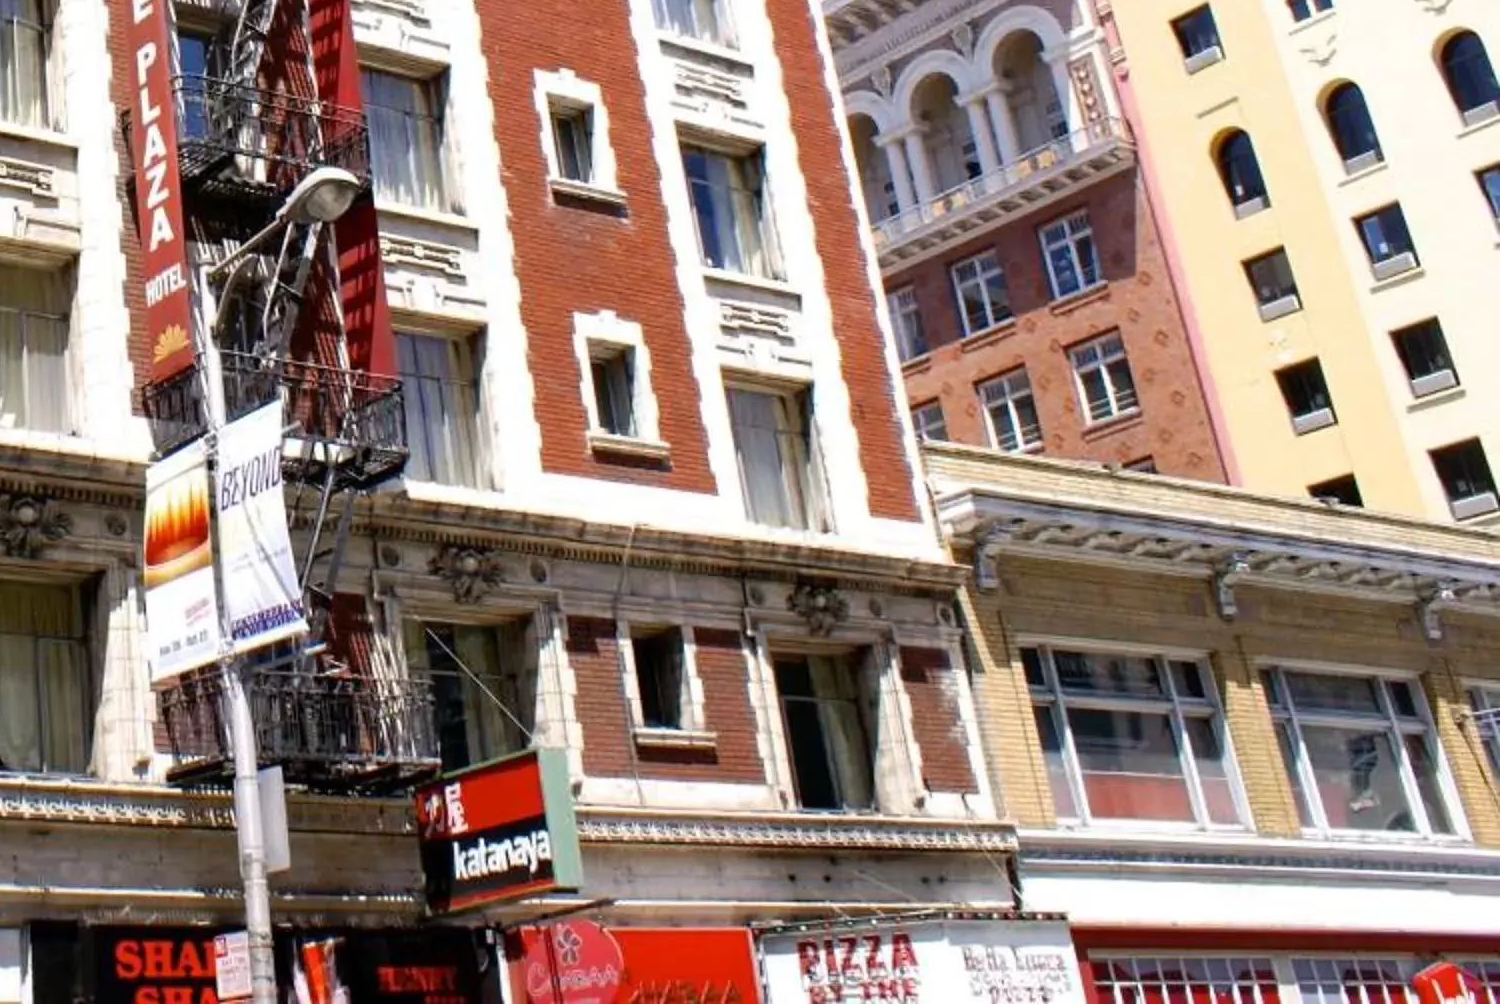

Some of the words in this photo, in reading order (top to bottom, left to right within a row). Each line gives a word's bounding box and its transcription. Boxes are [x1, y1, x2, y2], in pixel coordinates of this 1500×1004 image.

[135, 42, 174, 253] PLAZA
[145, 262, 187, 308] HOTEL
[220, 446, 282, 512] BEYOND
[452, 829, 552, 881] katanaya
[797, 933, 918, 980] PIZZA
